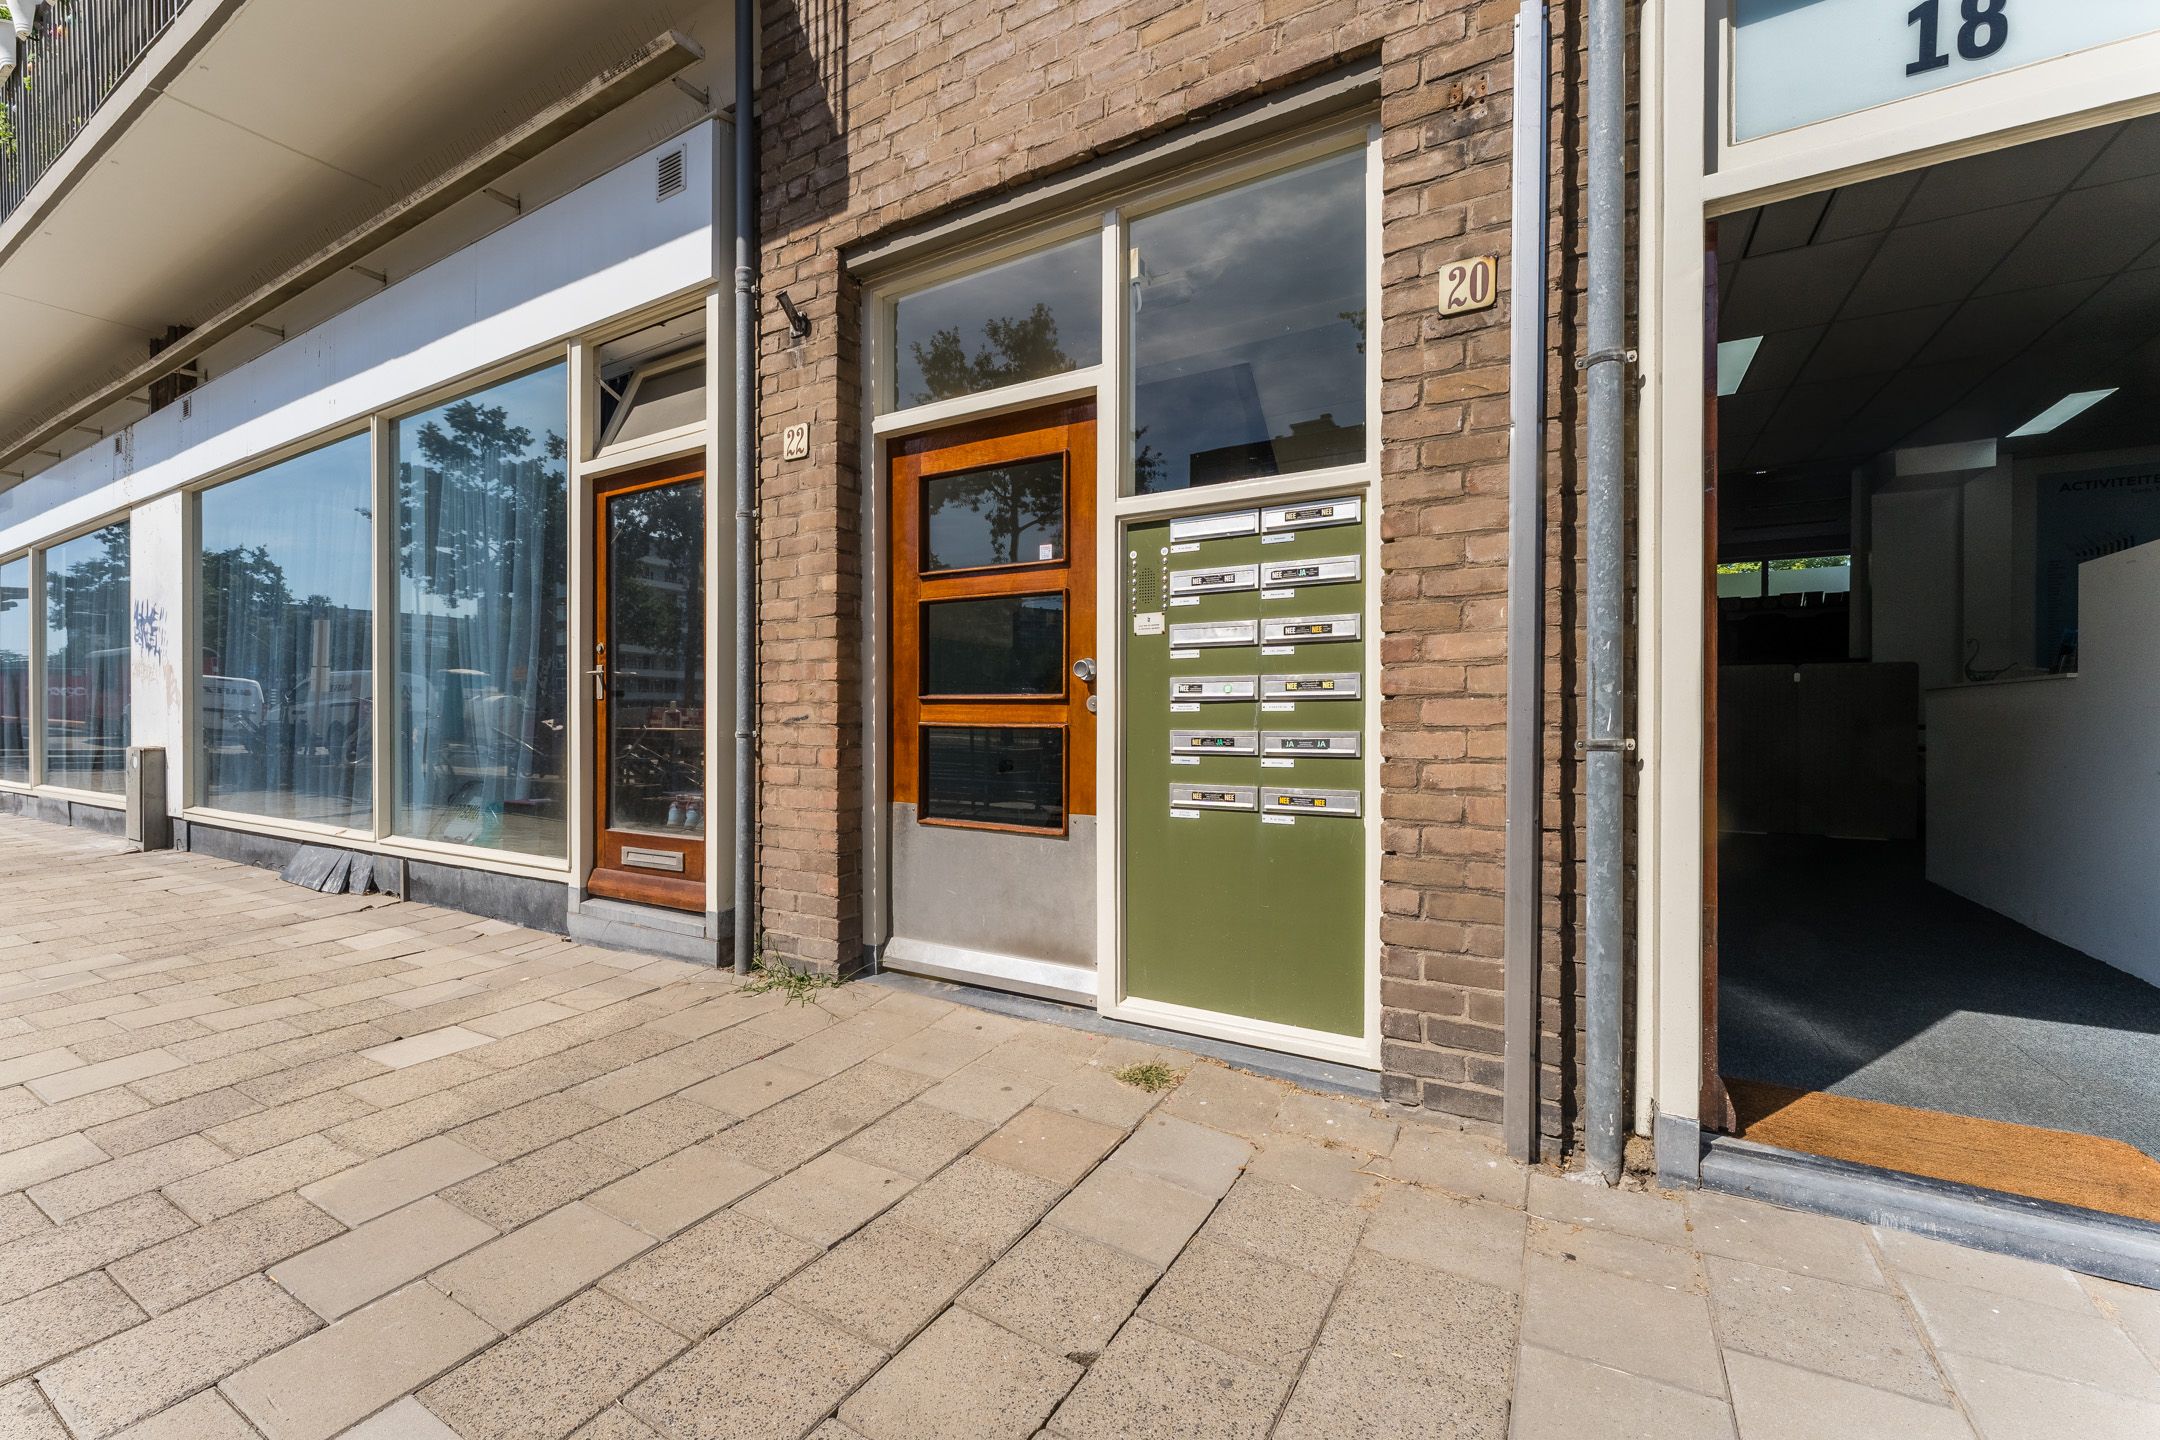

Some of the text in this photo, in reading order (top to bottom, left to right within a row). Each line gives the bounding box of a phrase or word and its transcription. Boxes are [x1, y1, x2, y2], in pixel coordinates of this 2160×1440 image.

[1906, 0, 2008, 77] 18
[1448, 261, 1490, 309] 20
[787, 427, 804, 456] 22
[1285, 512, 1297, 520] NEE
[1321, 507, 1333, 516] NEE
[1272, 571, 1283, 579] NEE
[1298, 568, 1307, 577] JA
[1192, 577, 1202, 585] NEE
[1224, 574, 1234, 582] NEE
[1284, 626, 1296, 634] NEE
[1311, 625, 1323, 633] NEE
[1286, 682, 1298, 690] NEE
[1322, 681, 1334, 689] NEE
[1317, 740, 1326, 748] JA
[1192, 792, 1202, 800] NEE
[1314, 799, 1325, 807] NEE
